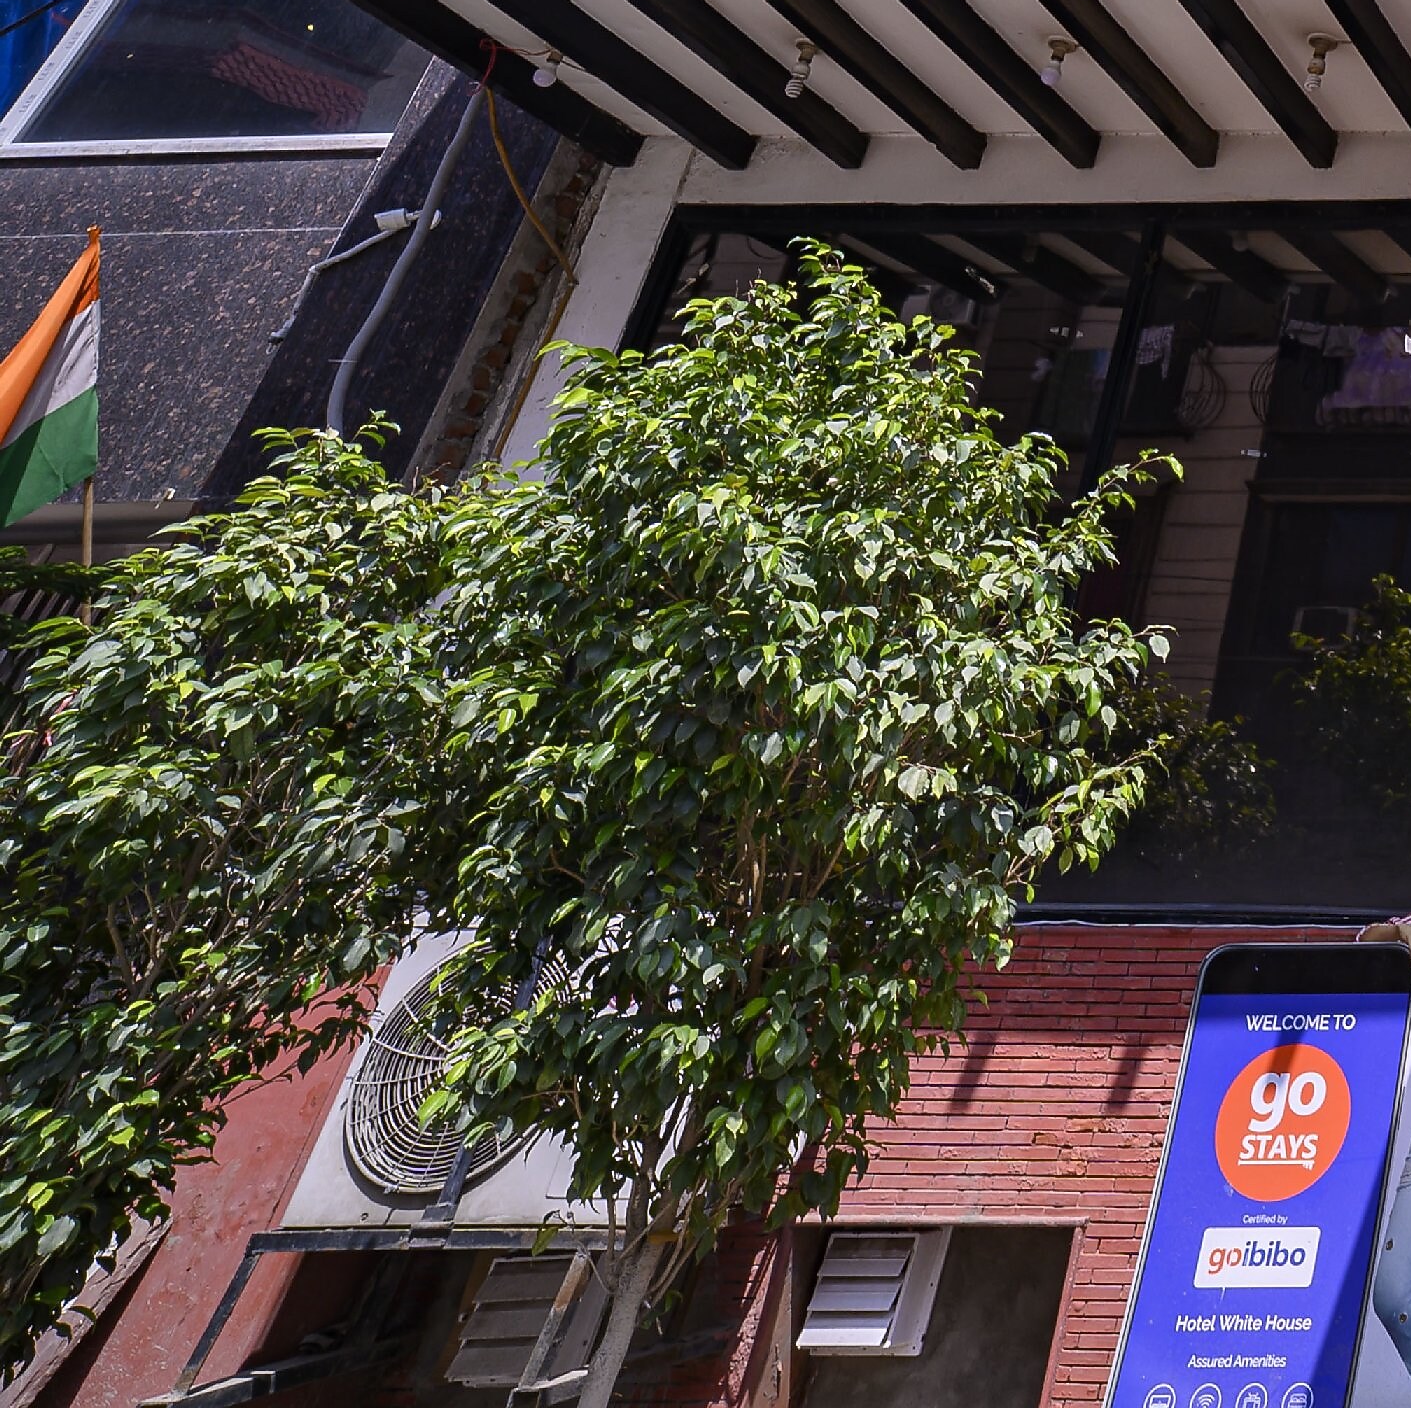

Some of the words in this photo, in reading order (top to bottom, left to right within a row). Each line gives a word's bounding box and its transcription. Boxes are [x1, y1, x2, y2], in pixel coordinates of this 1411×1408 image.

[1245, 1014, 1330, 1031] WELCOME
[1333, 1014, 1356, 1031] TO
[1248, 1070, 1327, 1133] go
[1240, 1134, 1319, 1162] STAYS
[1276, 1214, 1288, 1226] by
[1208, 1240, 1306, 1275] goibibo
[1175, 1314, 1215, 1332] Hotel
[1219, 1314, 1263, 1332] White
[1264, 1314, 1312, 1331] House
[1187, 1354, 1232, 1369] Assured
[1233, 1353, 1287, 1368] Amenities
